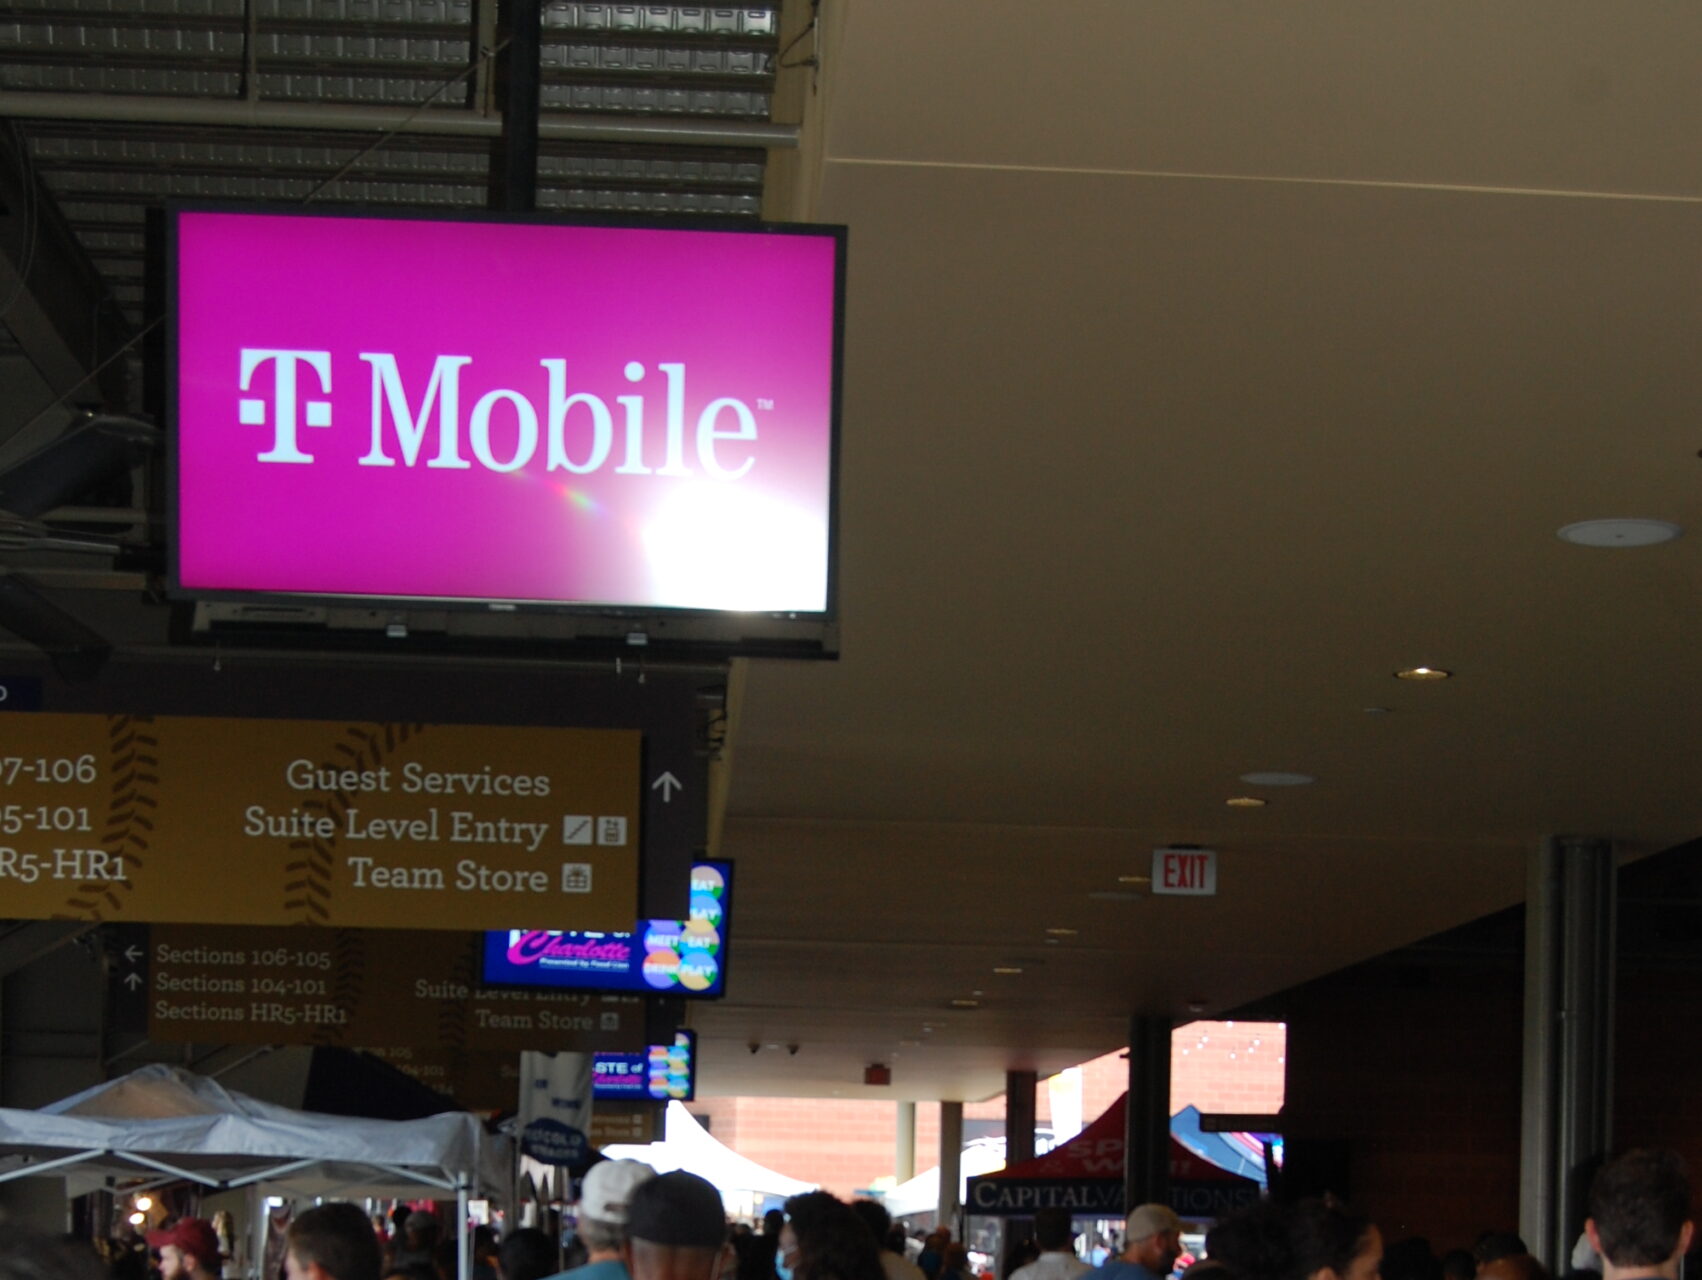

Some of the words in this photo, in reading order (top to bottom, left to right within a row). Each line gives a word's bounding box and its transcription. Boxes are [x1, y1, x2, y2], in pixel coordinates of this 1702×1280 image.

[358, 352, 758, 481] Mobile
[0, 754, 96, 785] 7-106
[286, 759, 390, 793] Guest
[401, 763, 550, 797] Services
[0, 805, 92, 834] 5-101
[244, 806, 335, 838] Suite
[346, 809, 439, 841] Level
[450, 812, 549, 852] Entry
[348, 857, 445, 889] Team
[456, 860, 549, 892] Store
[1164, 854, 1208, 888] EXIT
[156, 945, 245, 966] Sections
[252, 948, 331, 970] 106-105
[156, 972, 245, 993] Sections
[252, 976, 327, 996] 104-101
[415, 979, 469, 999] Suite
[155, 1001, 244, 1021] Sections
[251, 1004, 347, 1025] HR5-HR1
[475, 1009, 533, 1029] Team
[538, 1010, 593, 1031] Store
[594, 1062, 628, 1074] STE
